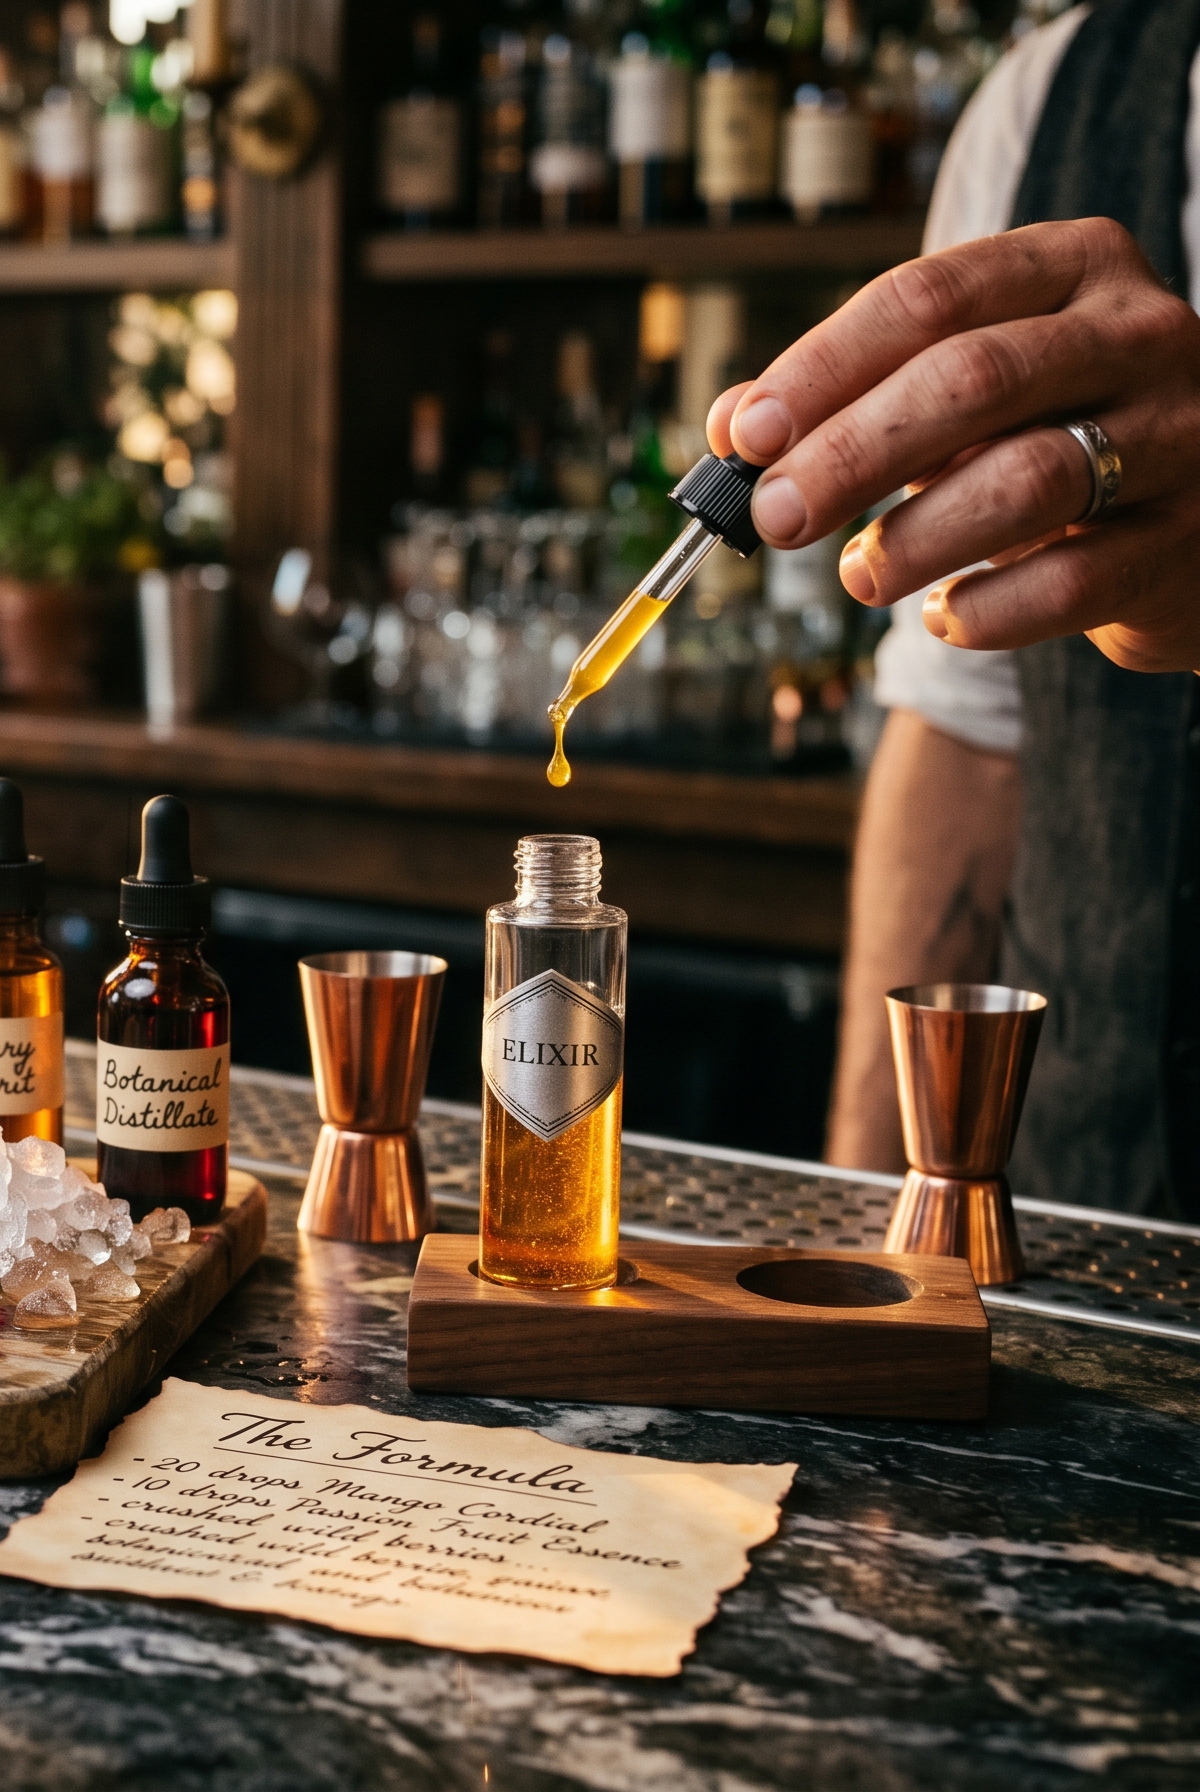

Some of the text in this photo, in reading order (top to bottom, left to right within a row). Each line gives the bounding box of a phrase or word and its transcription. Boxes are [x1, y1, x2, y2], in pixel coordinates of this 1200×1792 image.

[502, 1038, 599, 1066] ELIXIR
[104, 1058, 221, 1093] Botanical
[104, 1097, 218, 1129] Distillate
[218, 1412, 594, 1494] The Formula
[151, 1457, 201, 1473] 20
[208, 1465, 303, 1491] drops
[316, 1478, 446, 1514] Mango
[458, 1502, 609, 1534] Cordial
[105, 1518, 256, 1545] crushed
[258, 1541, 351, 1559] wild
[121, 1500, 275, 1528] crushed
[282, 1524, 380, 1543] wild
[132, 1476, 170, 1491] 10
[178, 1484, 275, 1508] drops
[286, 1496, 415, 1530] Passion
[430, 1517, 532, 1545] Fruit
[542, 1535, 683, 1570] Essence
